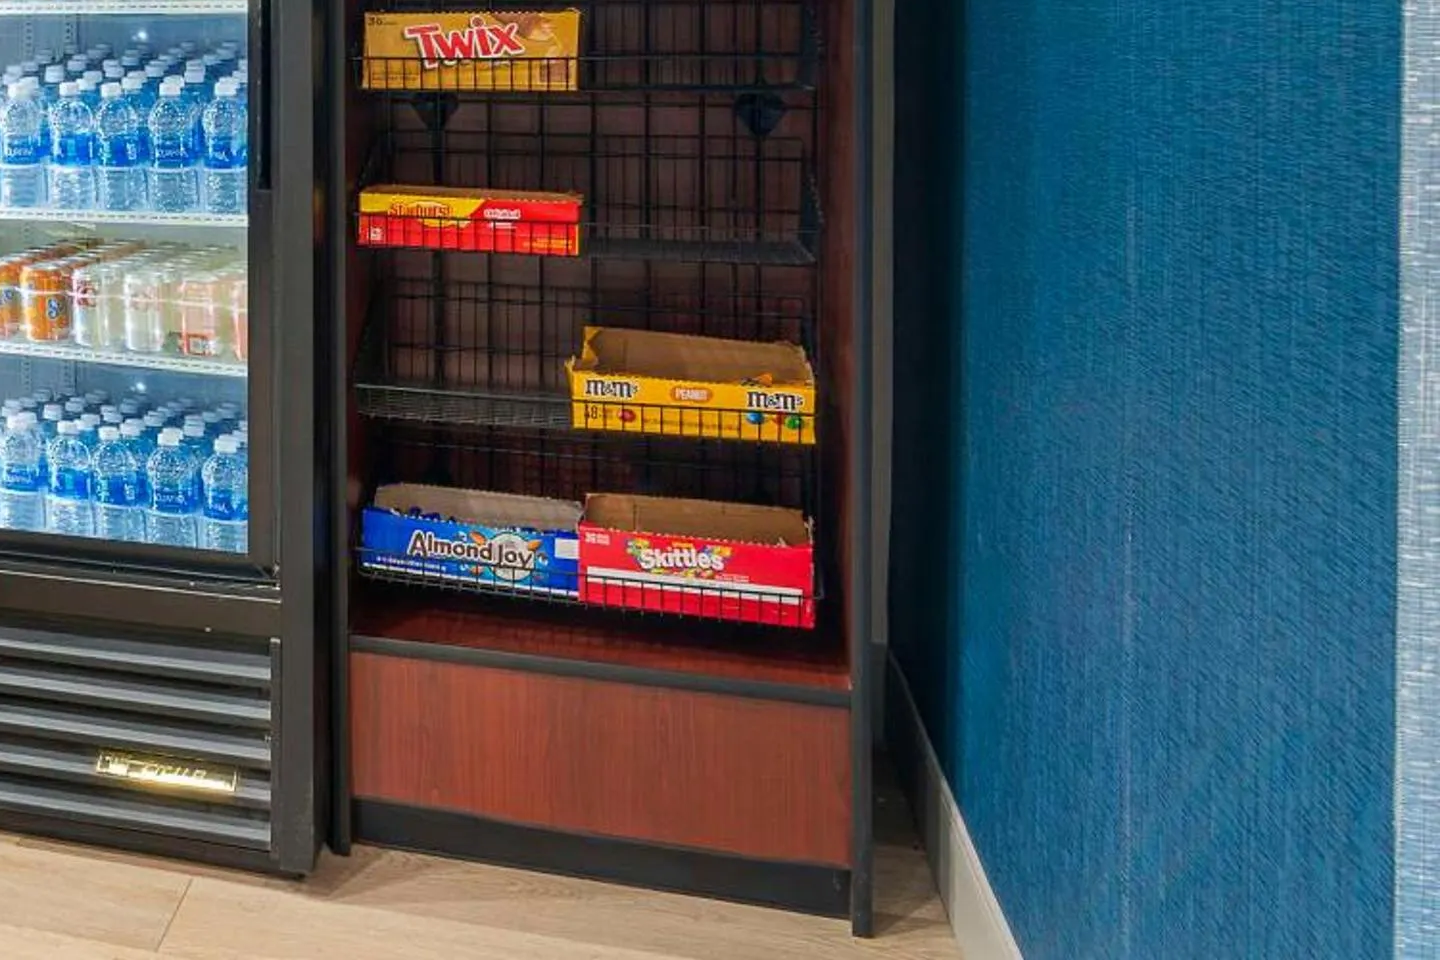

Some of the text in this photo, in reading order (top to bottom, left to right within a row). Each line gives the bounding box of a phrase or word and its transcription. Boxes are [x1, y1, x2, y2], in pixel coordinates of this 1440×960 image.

[407, 529, 537, 570] Almond Joy
[639, 547, 725, 571] Skittles
